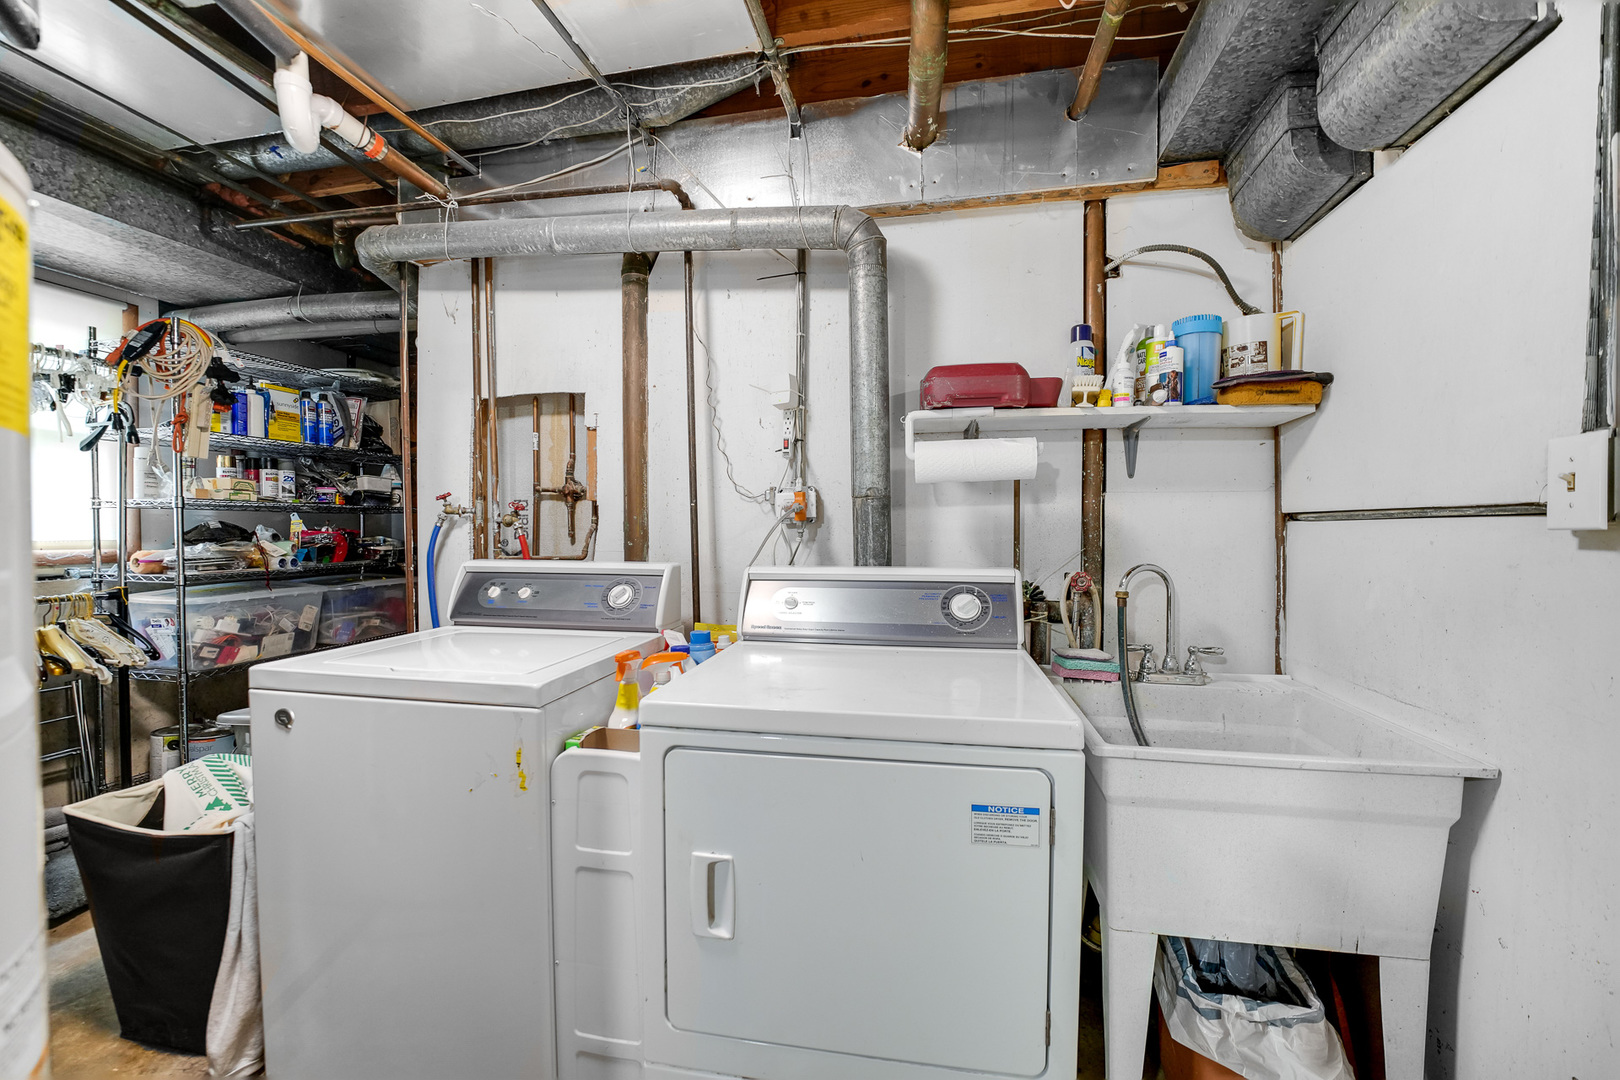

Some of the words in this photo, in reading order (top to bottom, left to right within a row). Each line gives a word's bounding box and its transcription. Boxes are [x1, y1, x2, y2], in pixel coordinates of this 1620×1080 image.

[189, 744, 213, 753] alspar
[175, 767, 207, 798] MERRY
[187, 762, 218, 797] CHRISTMA
[988, 806, 1025, 814] NOTICE
